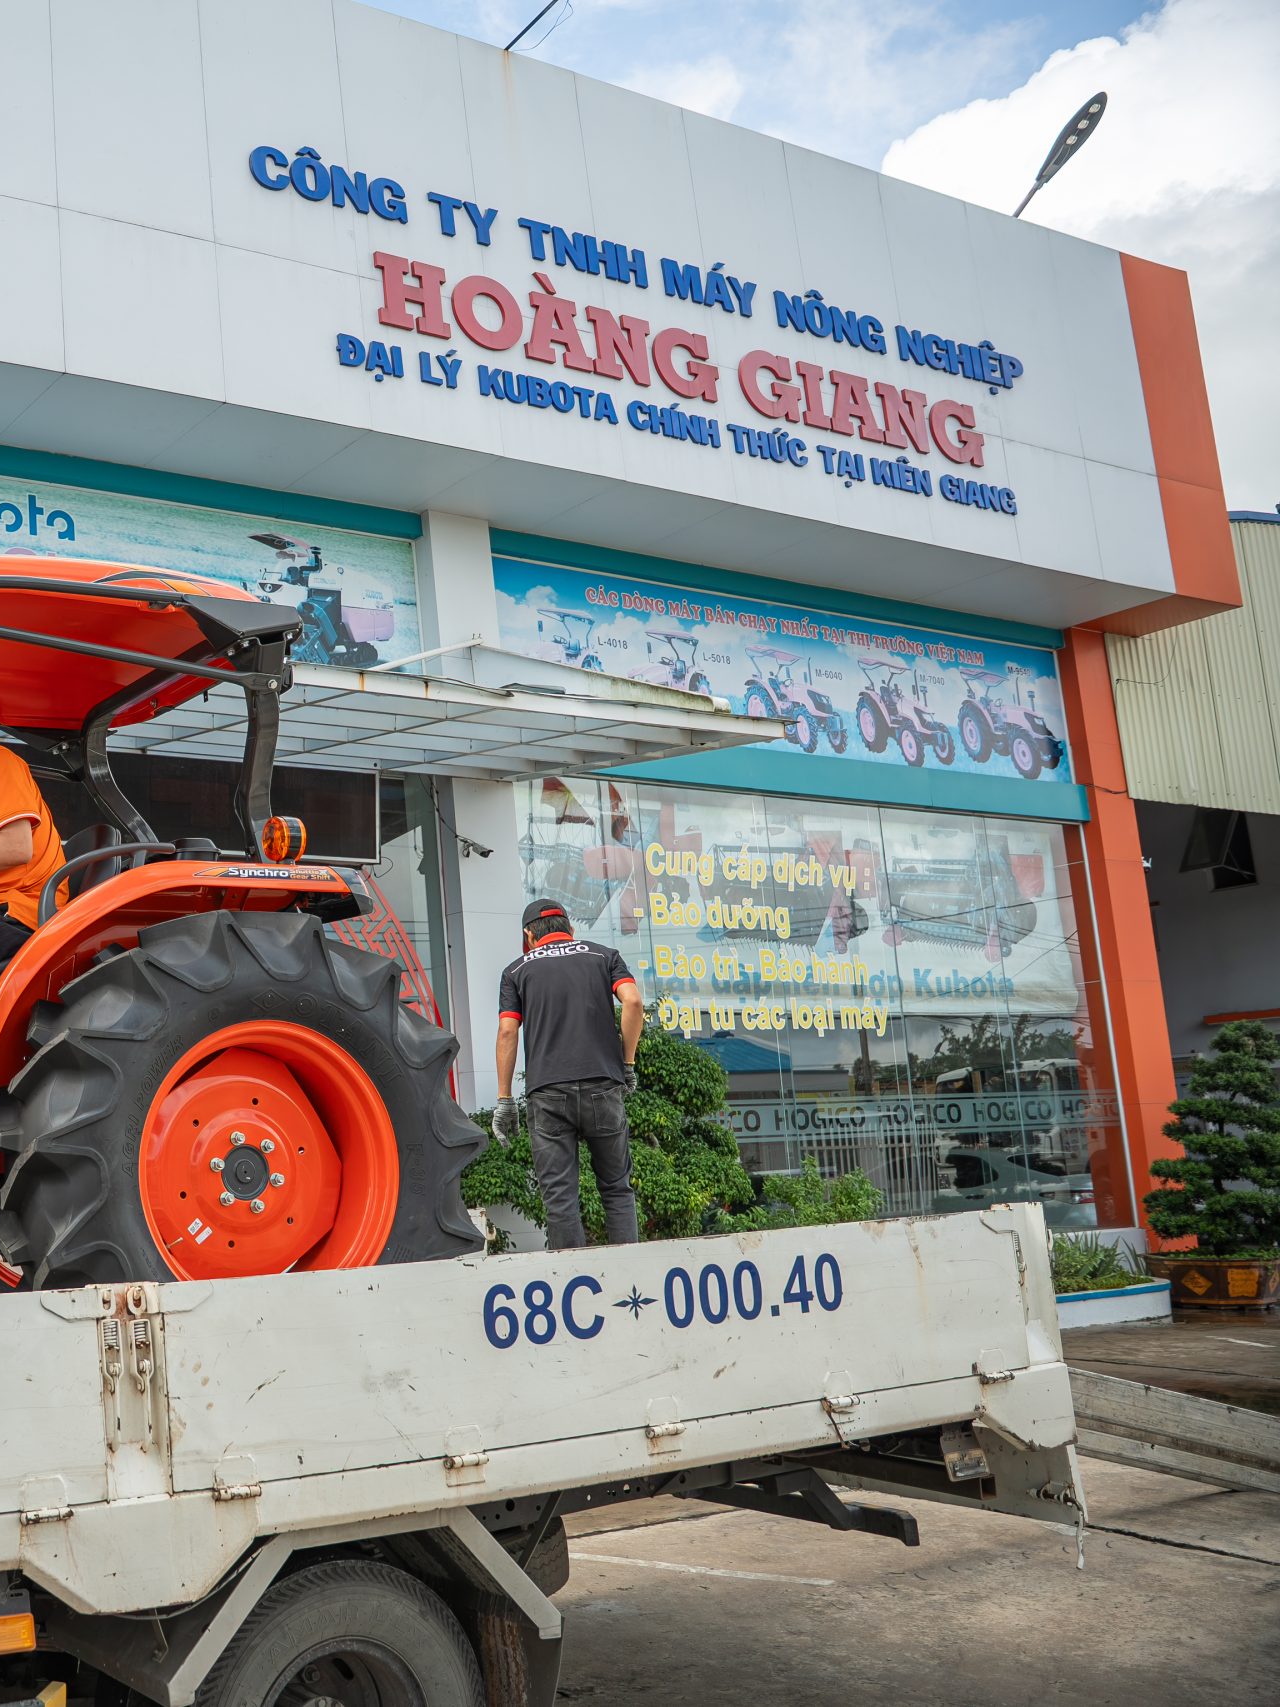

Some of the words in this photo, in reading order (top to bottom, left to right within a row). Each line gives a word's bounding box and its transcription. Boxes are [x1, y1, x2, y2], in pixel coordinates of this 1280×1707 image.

[249, 146, 408, 224] CÔNG
[427, 191, 498, 246] TY
[517, 217, 648, 289] TNHH
[660, 258, 757, 318] MÁY
[773, 289, 887, 355] NÔNG
[895, 325, 1024, 395] NGHIỆP
[373, 250, 719, 403] HOÀNG
[738, 348, 985, 468] GIANG
[336, 333, 404, 382] ĐẠI
[419, 350, 462, 388] LÝ
[478, 364, 618, 425] KUBOTA
[627, 400, 721, 448] CHÍNH
[727, 424, 808, 467] THỨC
[815, 445, 865, 488] TẠI
[870, 456, 933, 497] KIÊN
[939, 474, 1017, 515] GIANG
[585, 585, 620, 607] CÁC
[621, 591, 665, 615] DÒNG
[668, 599, 701, 621] MÁY
[738, 612, 778, 633] CHẠY
[780, 616, 819, 640] NHẤT
[821, 627, 846, 646] TẠI
[848, 631, 870, 650] THỊ
[873, 634, 923, 656] TRƯỜNG
[926, 643, 955, 663] VIỆT
[958, 650, 985, 666] NAM
[598, 636, 628, 649] L-4018
[703, 652, 731, 665] L-5018
[815, 668, 843, 681] M-6040
[919, 673, 945, 686] M-7040
[228, 867, 288, 879] Synchro
[646, 842, 714, 886] Cung
[723, 843, 767, 889] cấp
[773, 852, 822, 891] dịch
[828, 863, 856, 896] vụ
[649, 892, 702, 927] Bảo
[706, 896, 791, 939] dưỡng
[523, 944, 590, 962] HOGICO
[654, 945, 707, 980] Bảo
[758, 948, 807, 983] Bảo
[811, 951, 869, 985] hành
[913, 968, 1015, 998] Kubota
[708, 996, 736, 1031] tu
[742, 996, 786, 1030] các
[789, 997, 835, 1037] loại
[840, 996, 888, 1037] máy
[773, 1105, 866, 1132] HOGICO
[483, 1275, 606, 1349] 68C
[664, 1252, 843, 1329] 000.40
